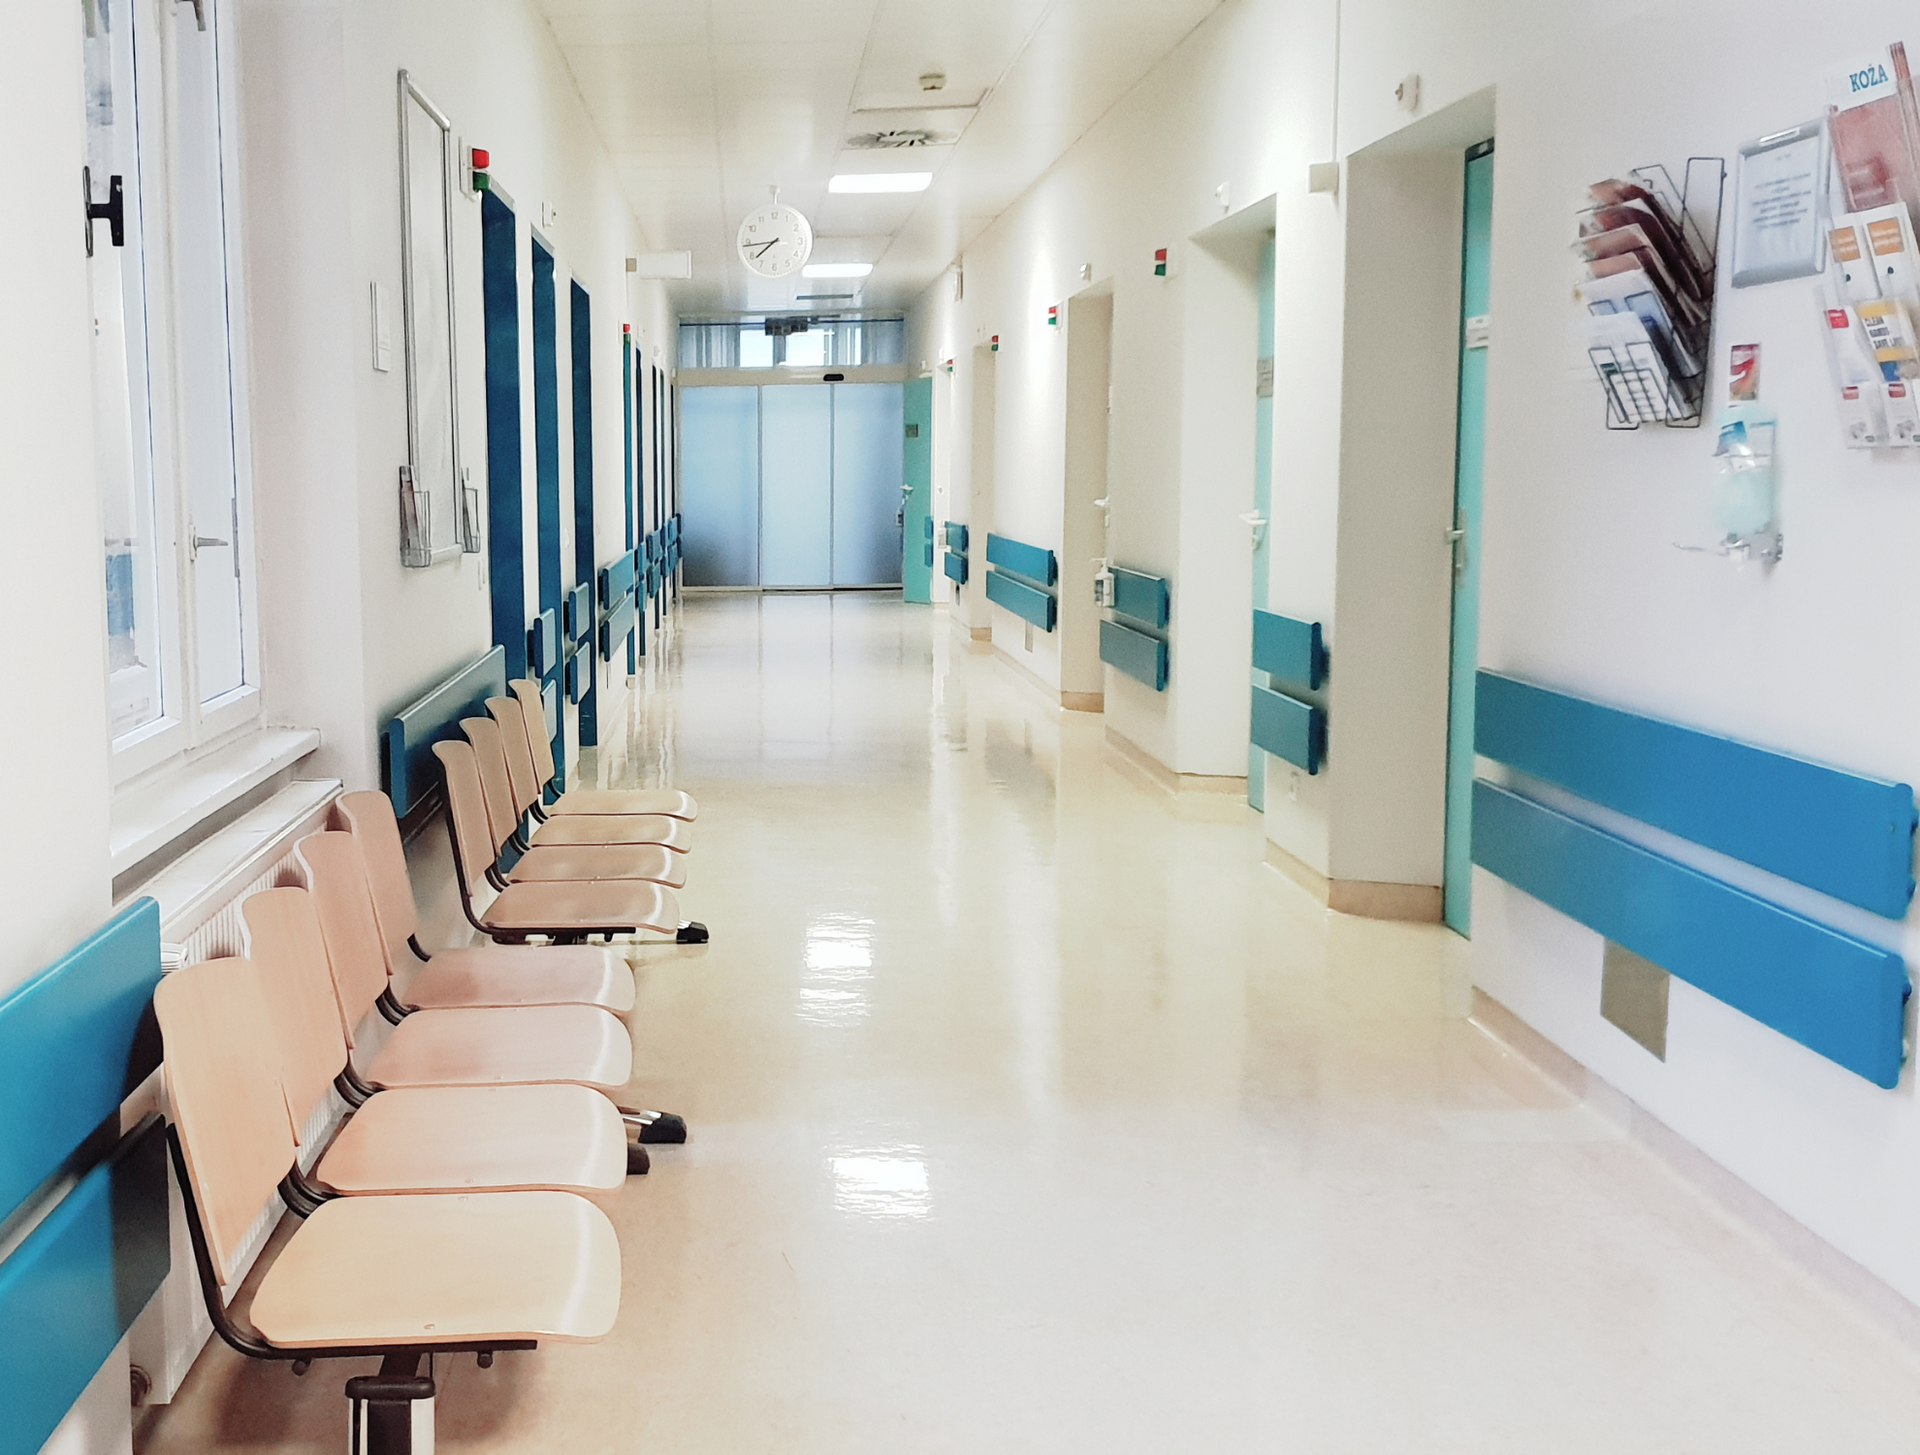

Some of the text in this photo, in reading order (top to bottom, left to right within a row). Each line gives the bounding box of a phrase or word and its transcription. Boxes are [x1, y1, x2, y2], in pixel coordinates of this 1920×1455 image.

[1849, 63, 1889, 93] KOŻA
[770, 211, 779, 220] 12
[748, 225, 757, 233] 10
[793, 223, 799, 232] 2
[797, 237, 803, 246] 3
[749, 252, 755, 260] 8
[759, 260, 764, 268] 7
[771, 263, 777, 271] 6
[784, 259, 790, 268] 5
